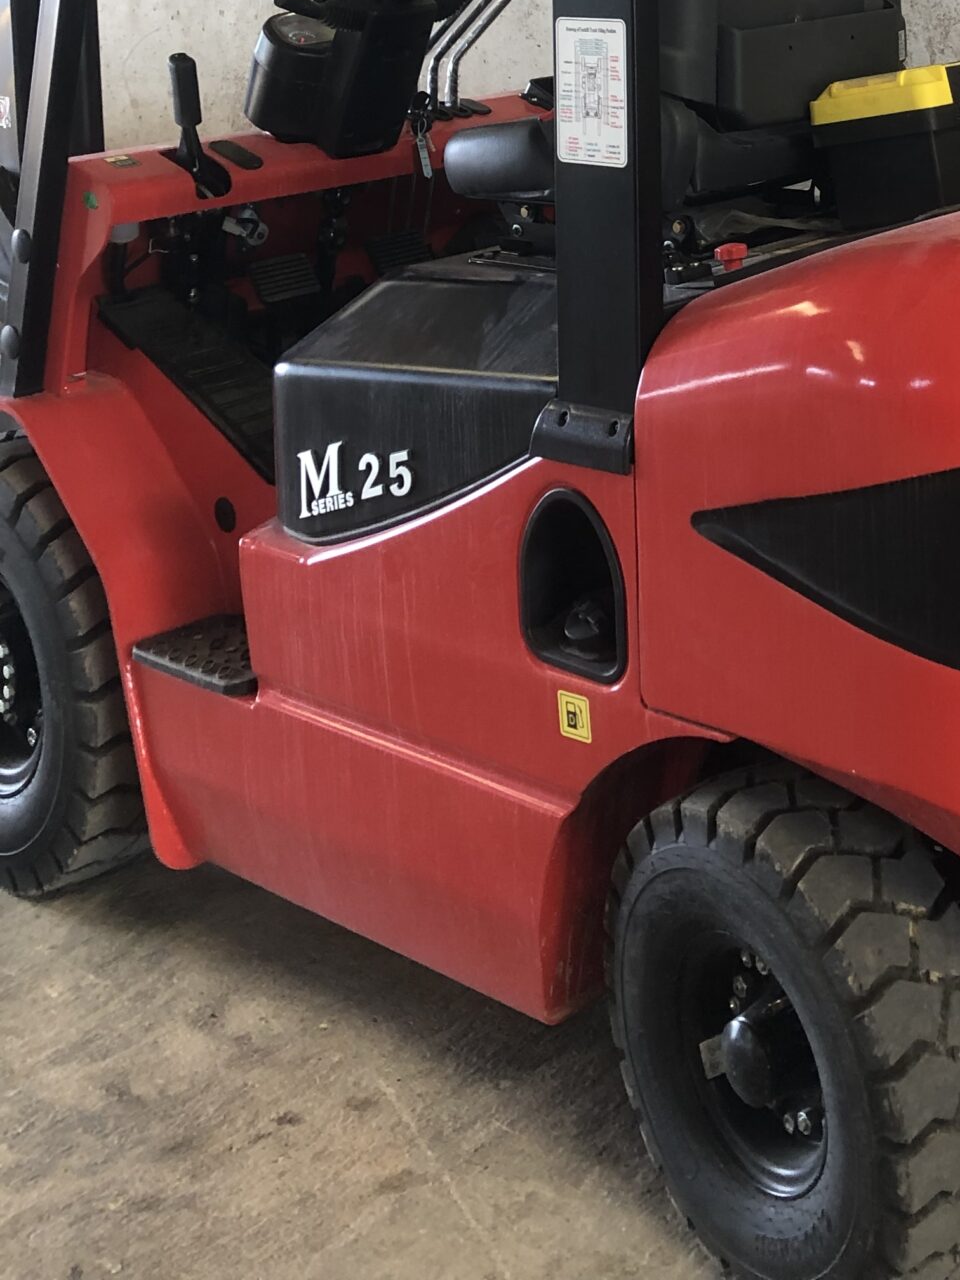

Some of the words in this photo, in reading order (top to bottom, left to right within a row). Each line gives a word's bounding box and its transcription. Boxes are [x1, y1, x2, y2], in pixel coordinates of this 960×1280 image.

[297, 440, 343, 519] M
[358, 449, 412, 500] 25
[311, 491, 354, 516] SERIES
